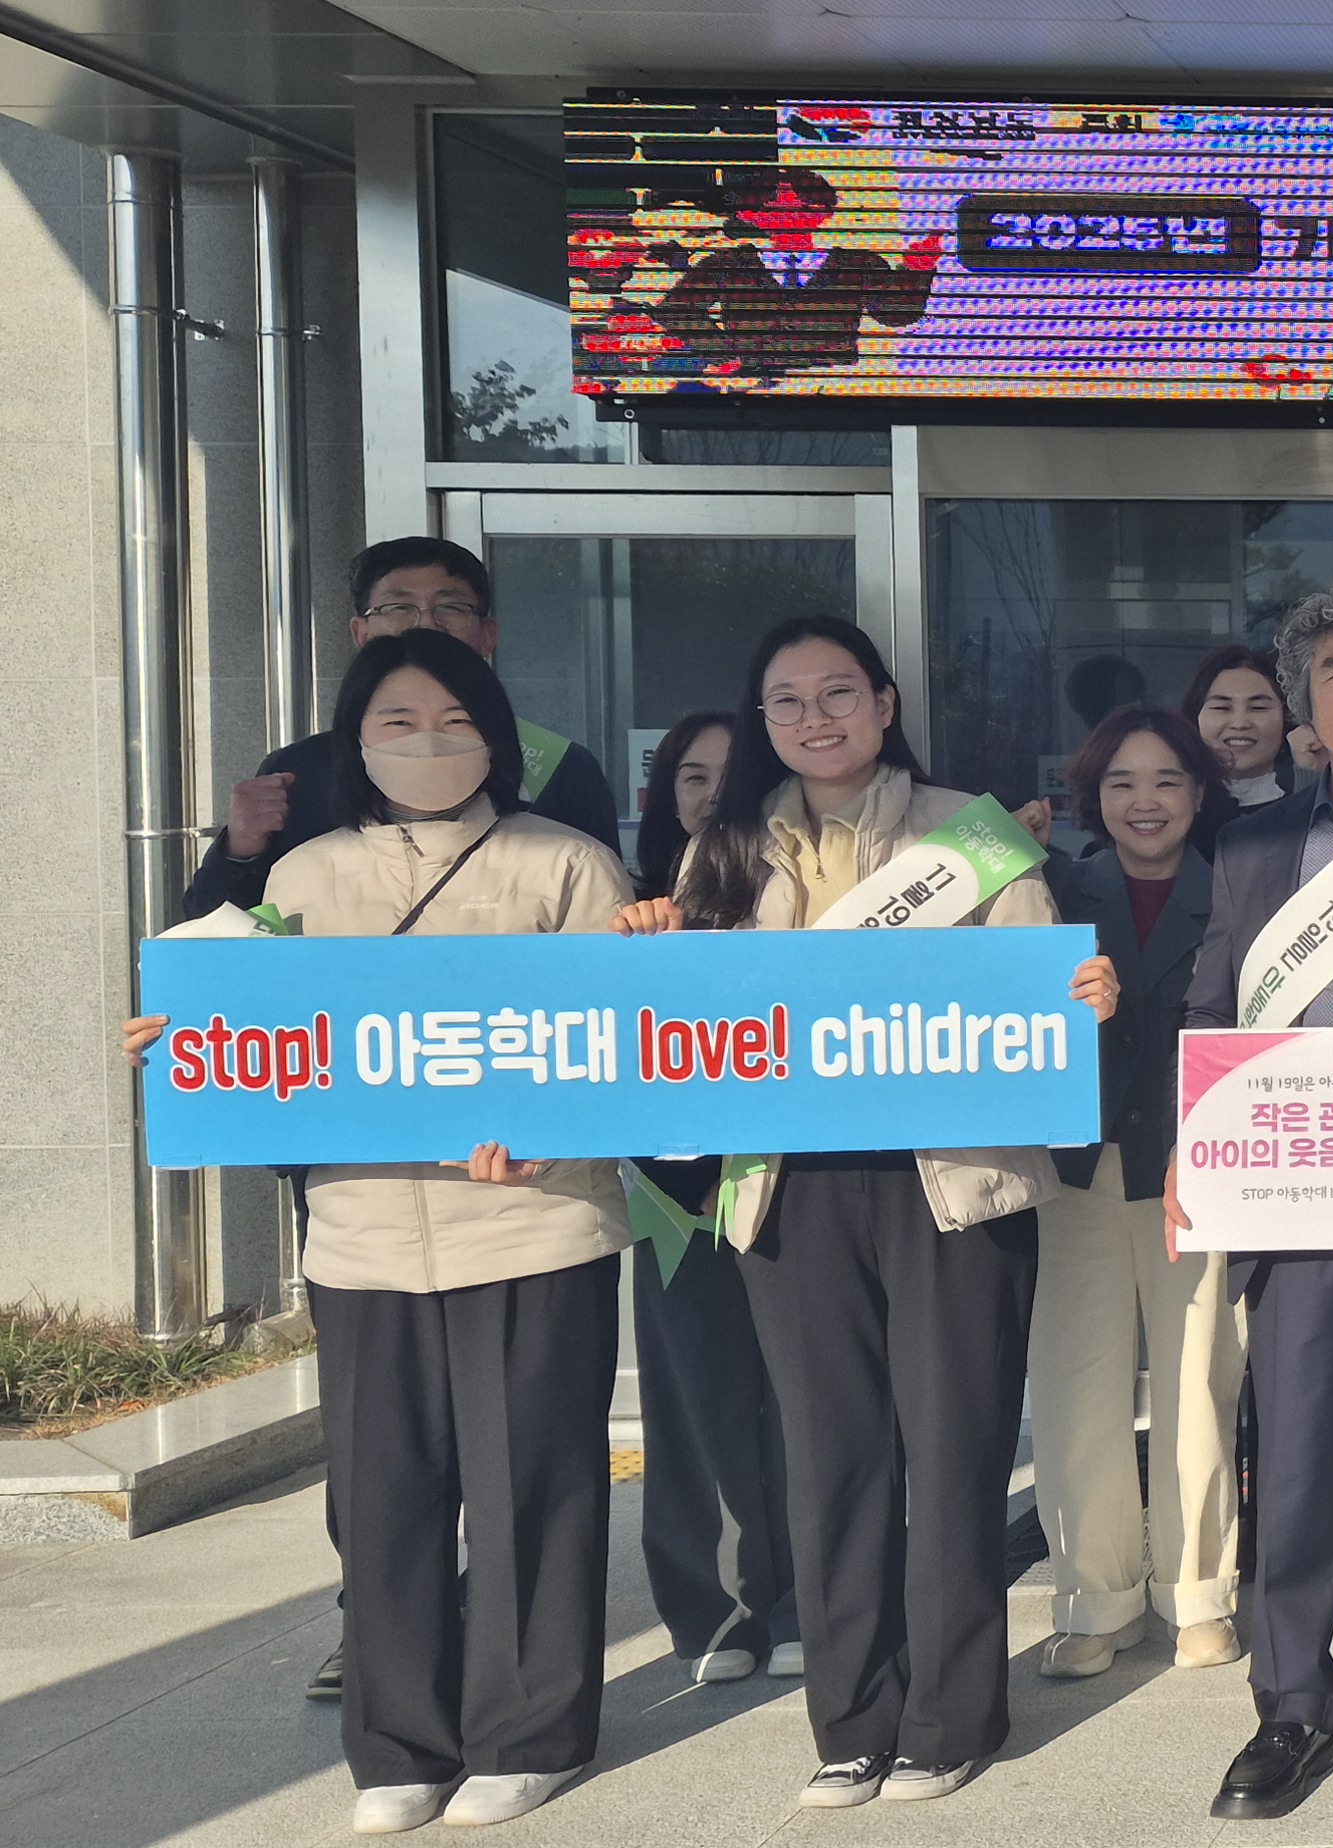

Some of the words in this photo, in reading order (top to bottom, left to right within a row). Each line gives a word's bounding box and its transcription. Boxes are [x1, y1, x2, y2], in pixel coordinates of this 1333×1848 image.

[988, 212, 1227, 254] 2025년
[955, 824, 1006, 875] 아동학대
[972, 820, 1014, 860] stop!
[900, 862, 956, 909] 11월
[1239, 965, 1286, 1028] 아동학
[169, 1011, 332, 1102] stop!
[355, 1006, 617, 1088] 아동학대
[638, 1003, 790, 1084] love!
[810, 1001, 1067, 1078] children
[1247, 1075, 1274, 1092] 11월
[1278, 1075, 1316, 1091] 19일은
[1250, 1102, 1310, 1133] 작은
[1190, 1138, 1279, 1170] 아이의
[1241, 1187, 1274, 1201] STOP
[1276, 1185, 1328, 1201] 아동학대
